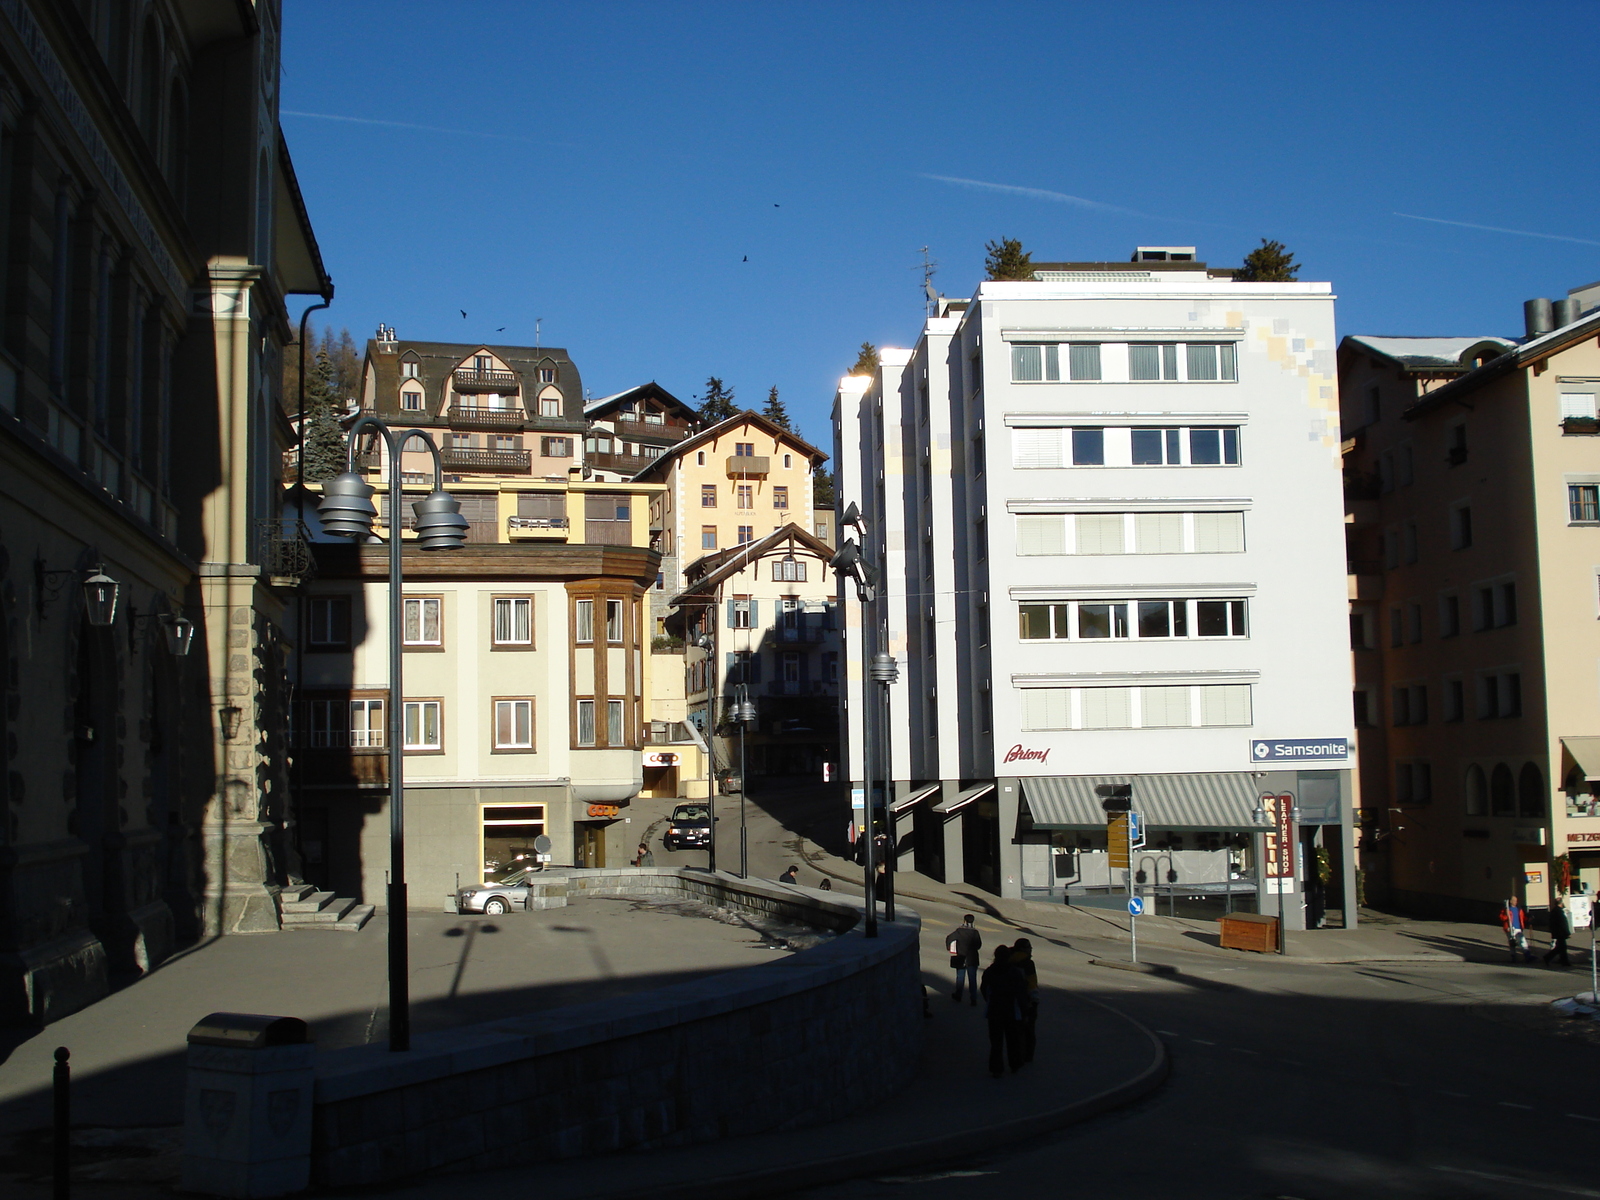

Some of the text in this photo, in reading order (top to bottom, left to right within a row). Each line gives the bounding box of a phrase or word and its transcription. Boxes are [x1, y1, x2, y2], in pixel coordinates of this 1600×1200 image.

[1275, 743, 1346, 756] Samsonite
[649, 754, 679, 765] coop
[587, 804, 620, 820] coop
